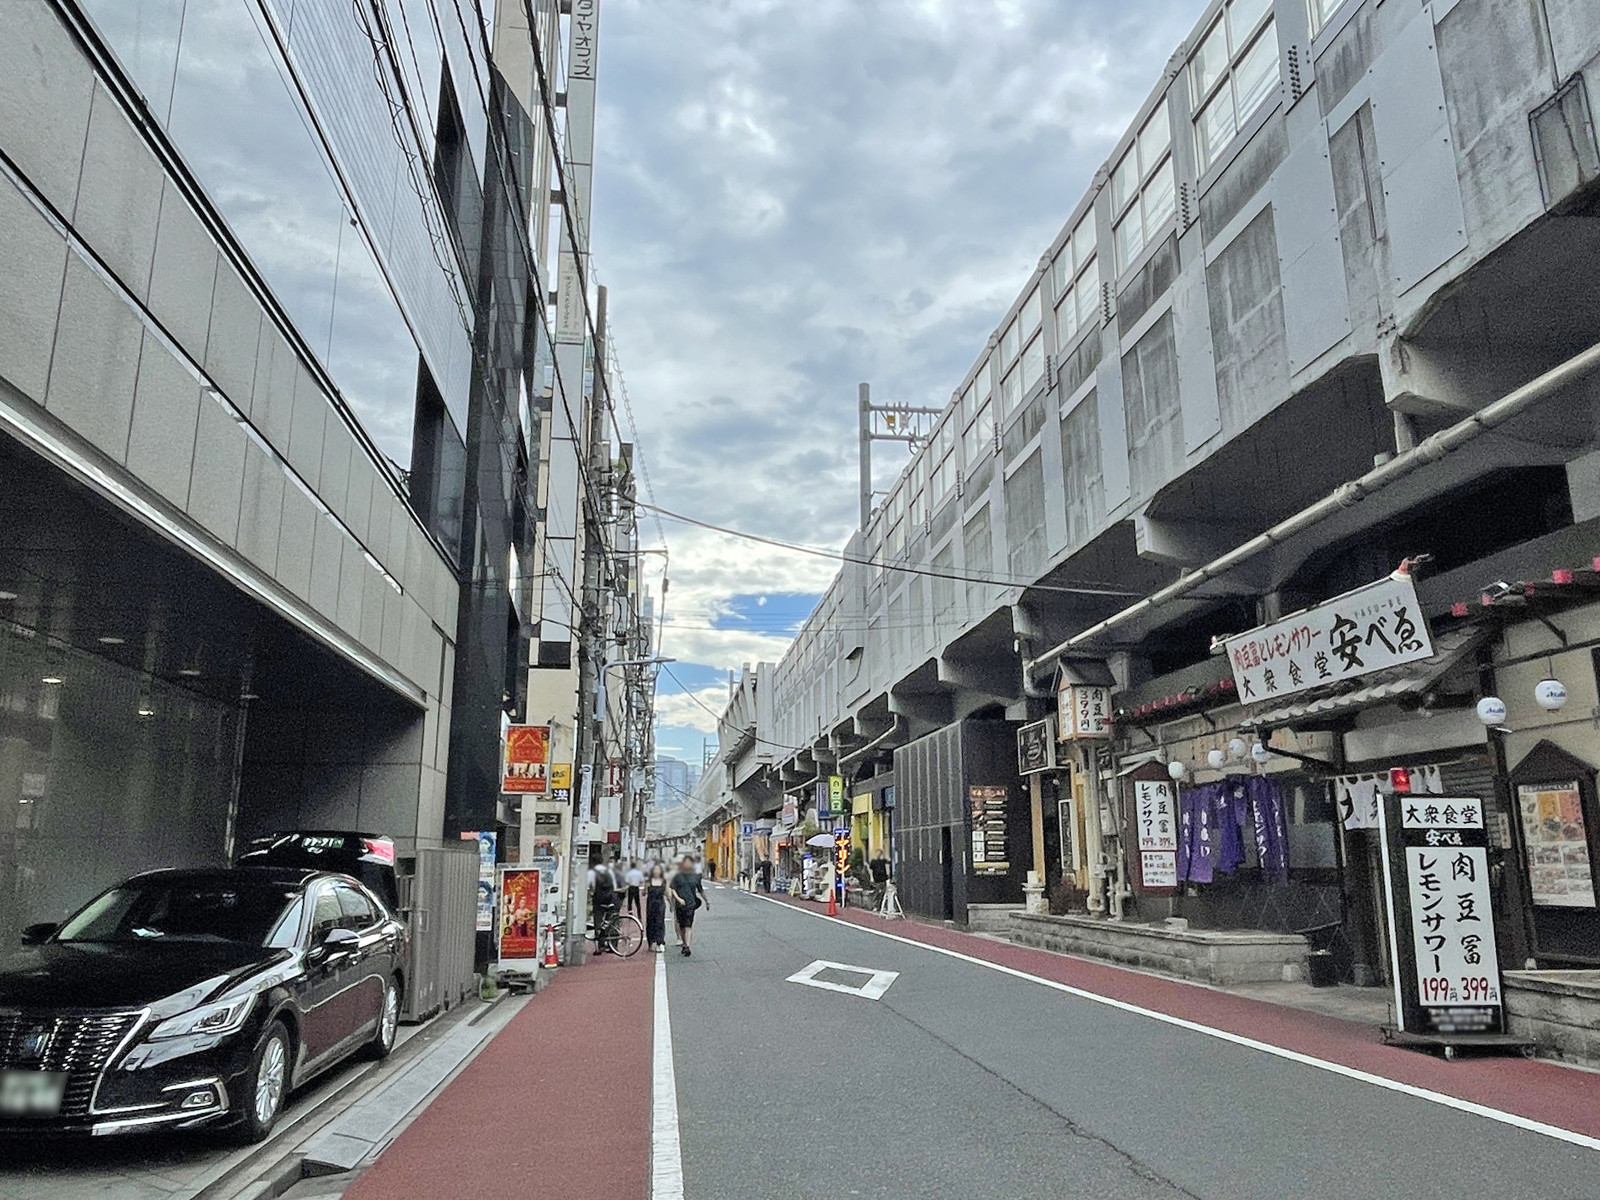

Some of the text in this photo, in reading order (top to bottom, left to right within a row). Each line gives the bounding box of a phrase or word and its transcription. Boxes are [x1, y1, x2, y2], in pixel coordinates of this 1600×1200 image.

[1242, 651, 1333, 699] 大衆食堂
[1140, 783, 1154, 836] レモンサワー
[1405, 803, 1479, 826] 大衆食堂
[1417, 852, 1447, 973] レモンサワー
